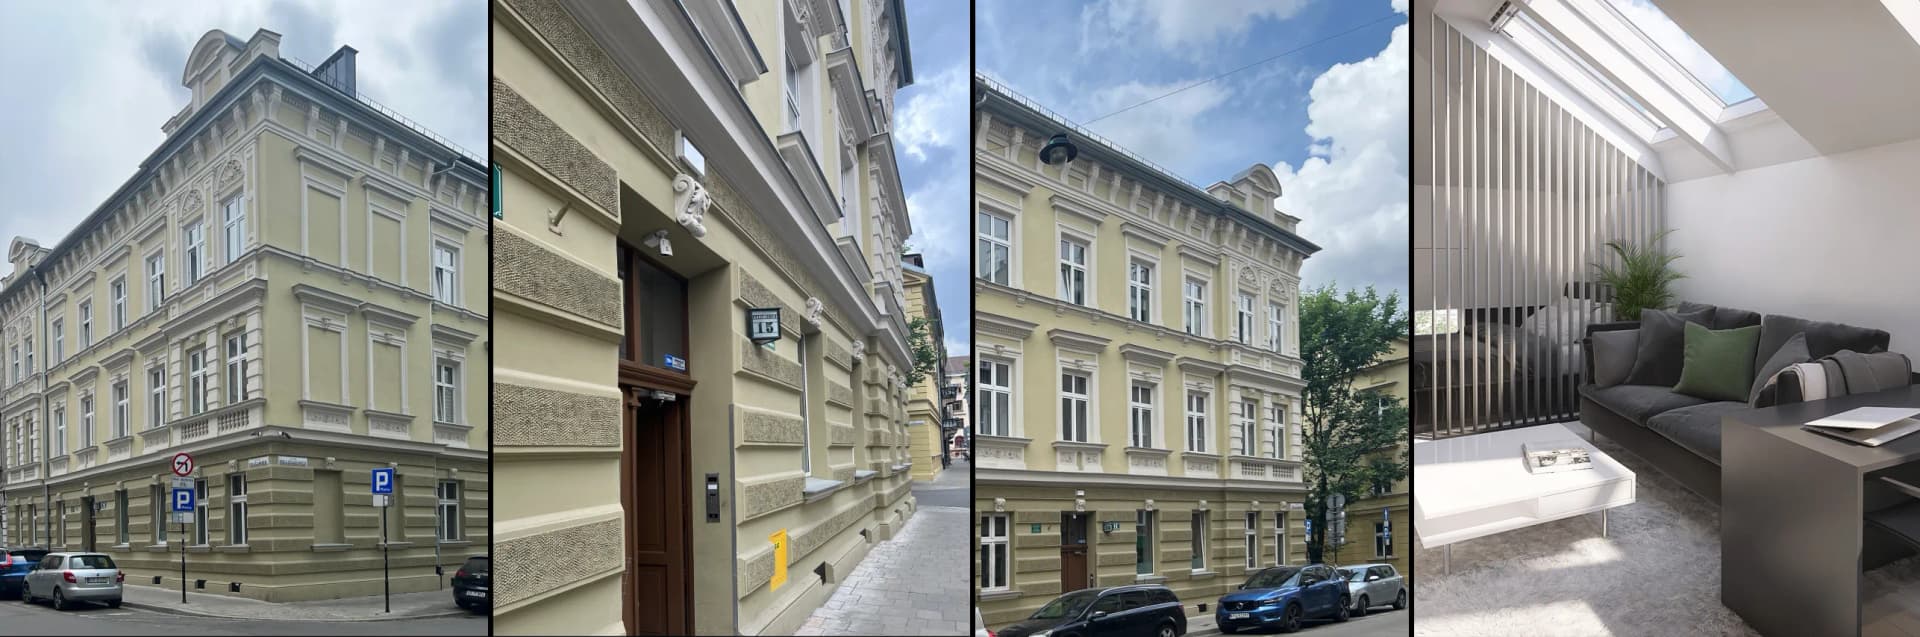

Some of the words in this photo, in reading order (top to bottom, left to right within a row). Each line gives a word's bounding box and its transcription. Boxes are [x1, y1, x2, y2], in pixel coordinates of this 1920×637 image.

[758, 321, 774, 334] 15
[376, 471, 389, 491] P
[176, 491, 190, 510] P
